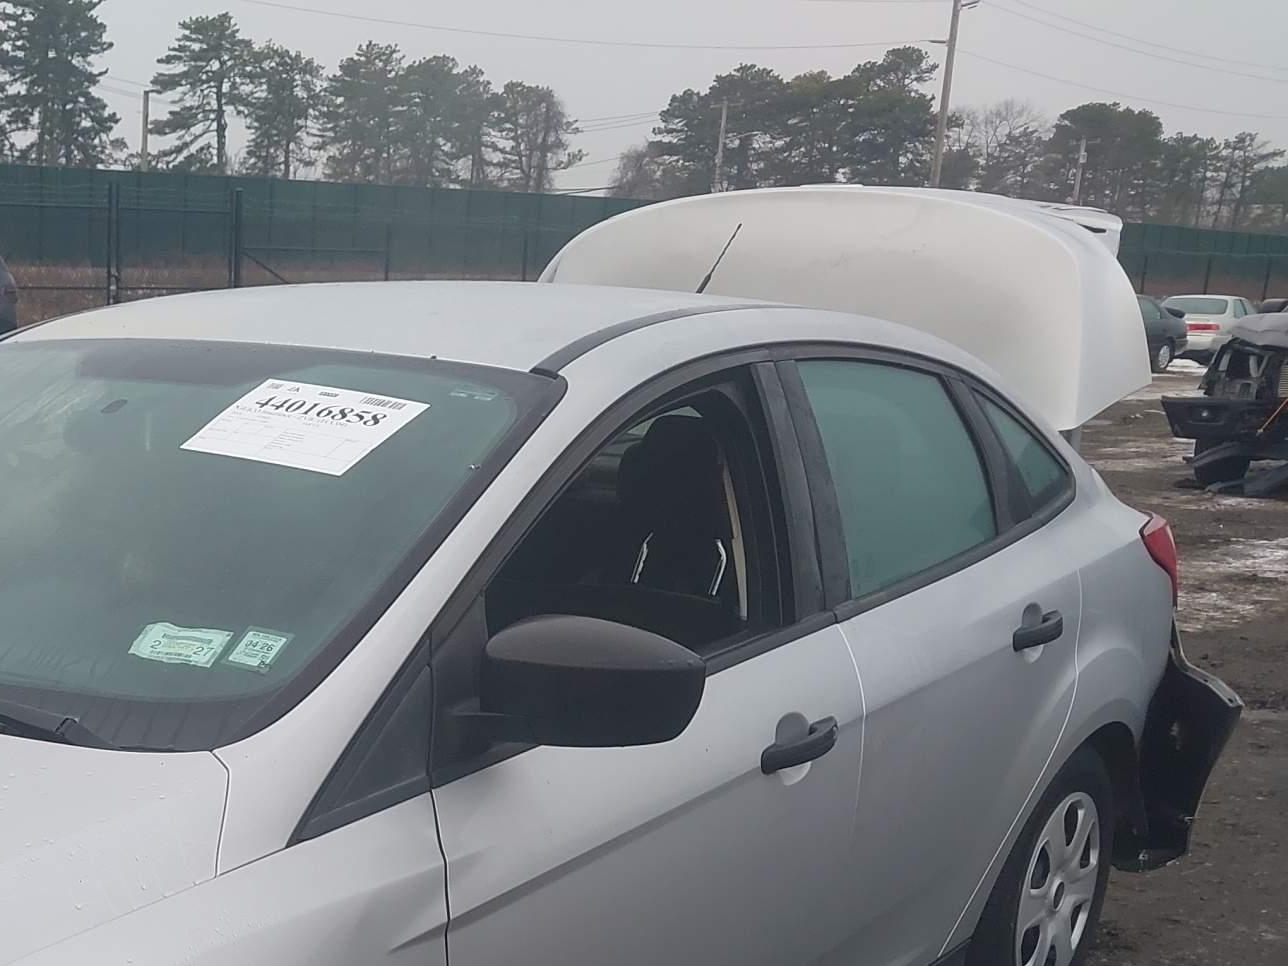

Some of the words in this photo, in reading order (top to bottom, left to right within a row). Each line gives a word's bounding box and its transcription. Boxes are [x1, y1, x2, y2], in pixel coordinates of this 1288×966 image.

[256, 396, 388, 427] 44016858
[150, 639, 162, 650] 2
[192, 646, 215, 657] 27
